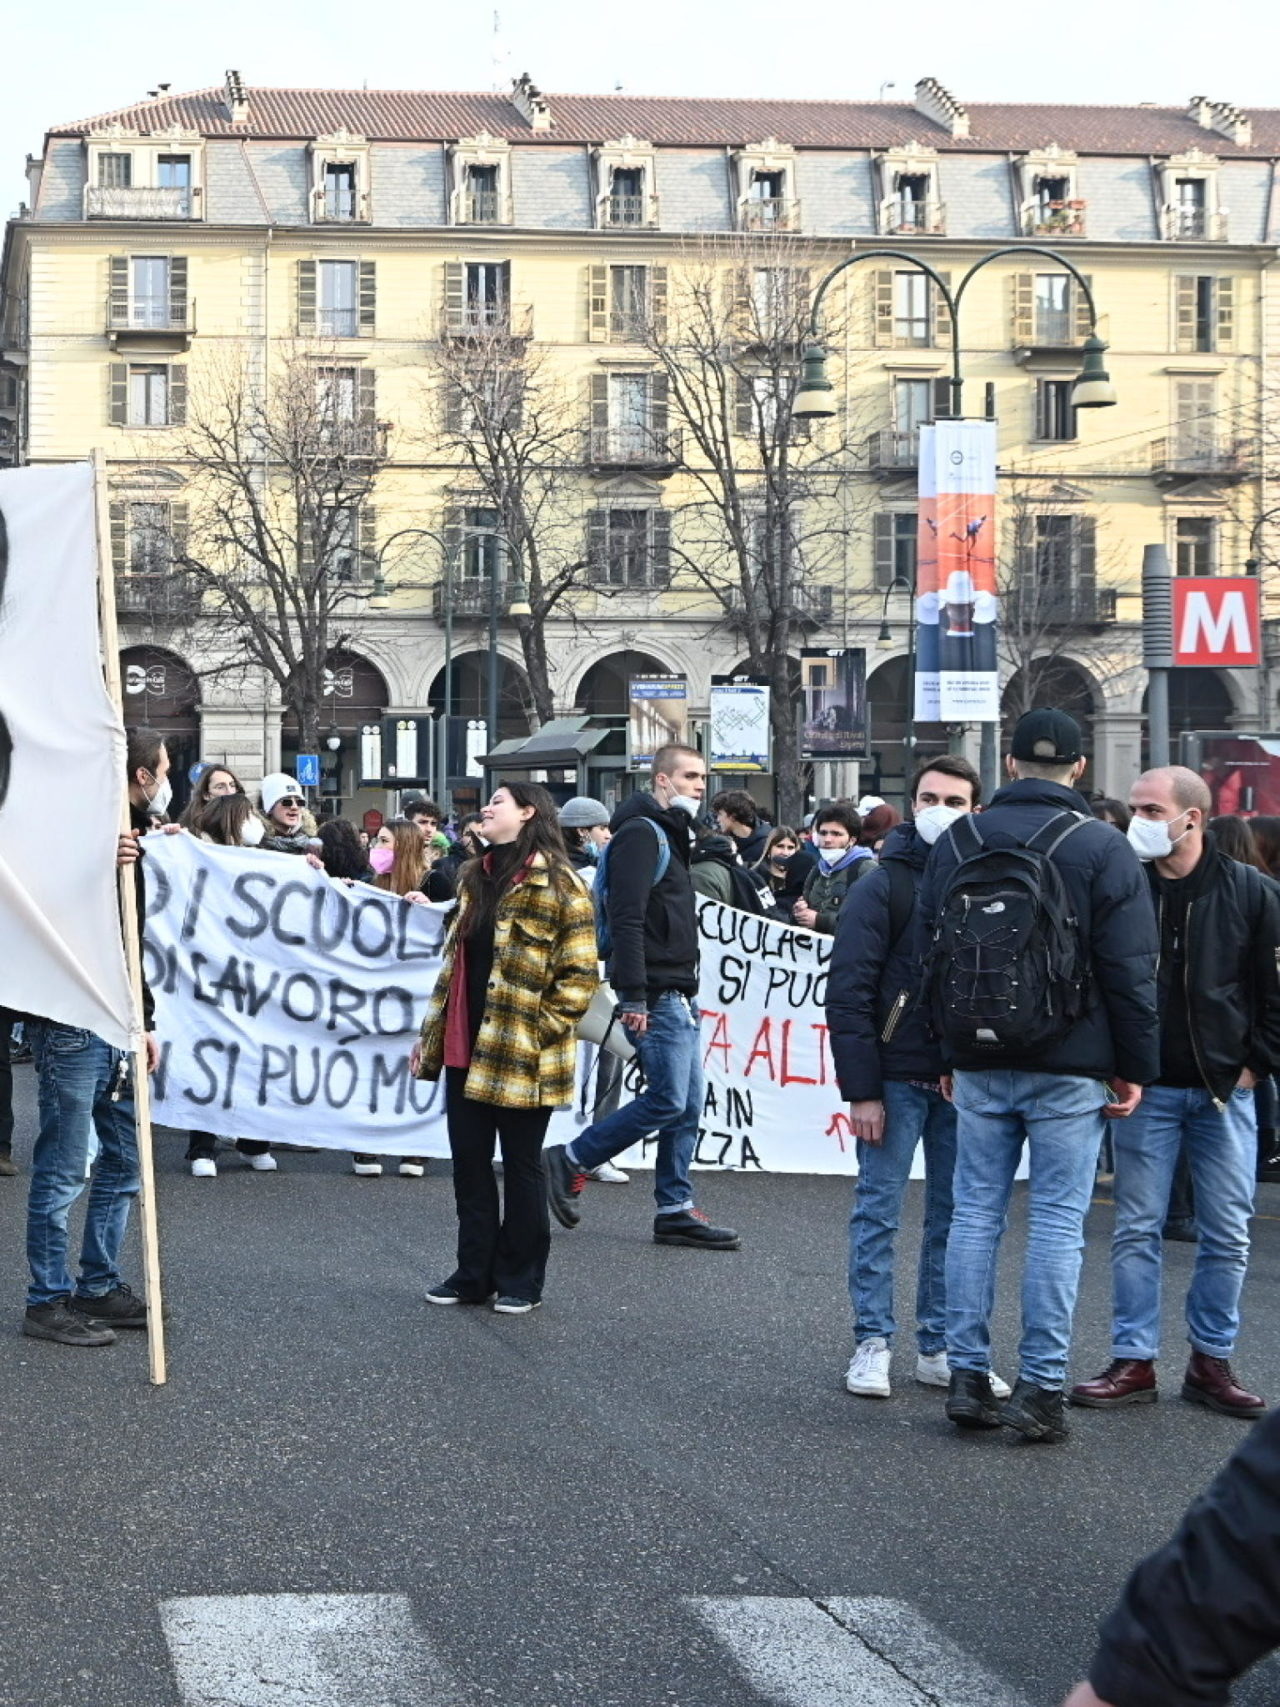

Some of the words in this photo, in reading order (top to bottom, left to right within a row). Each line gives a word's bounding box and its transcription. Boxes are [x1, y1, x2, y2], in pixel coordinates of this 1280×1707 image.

[1178, 591, 1254, 654] M
[225, 870, 445, 961] SCUOL
[190, 952, 415, 1037] LAVORO
[718, 955, 752, 1005] SI
[183, 1038, 241, 1111] SI
[743, 1016, 841, 1088] ALT
[726, 1087, 754, 1130] IN
